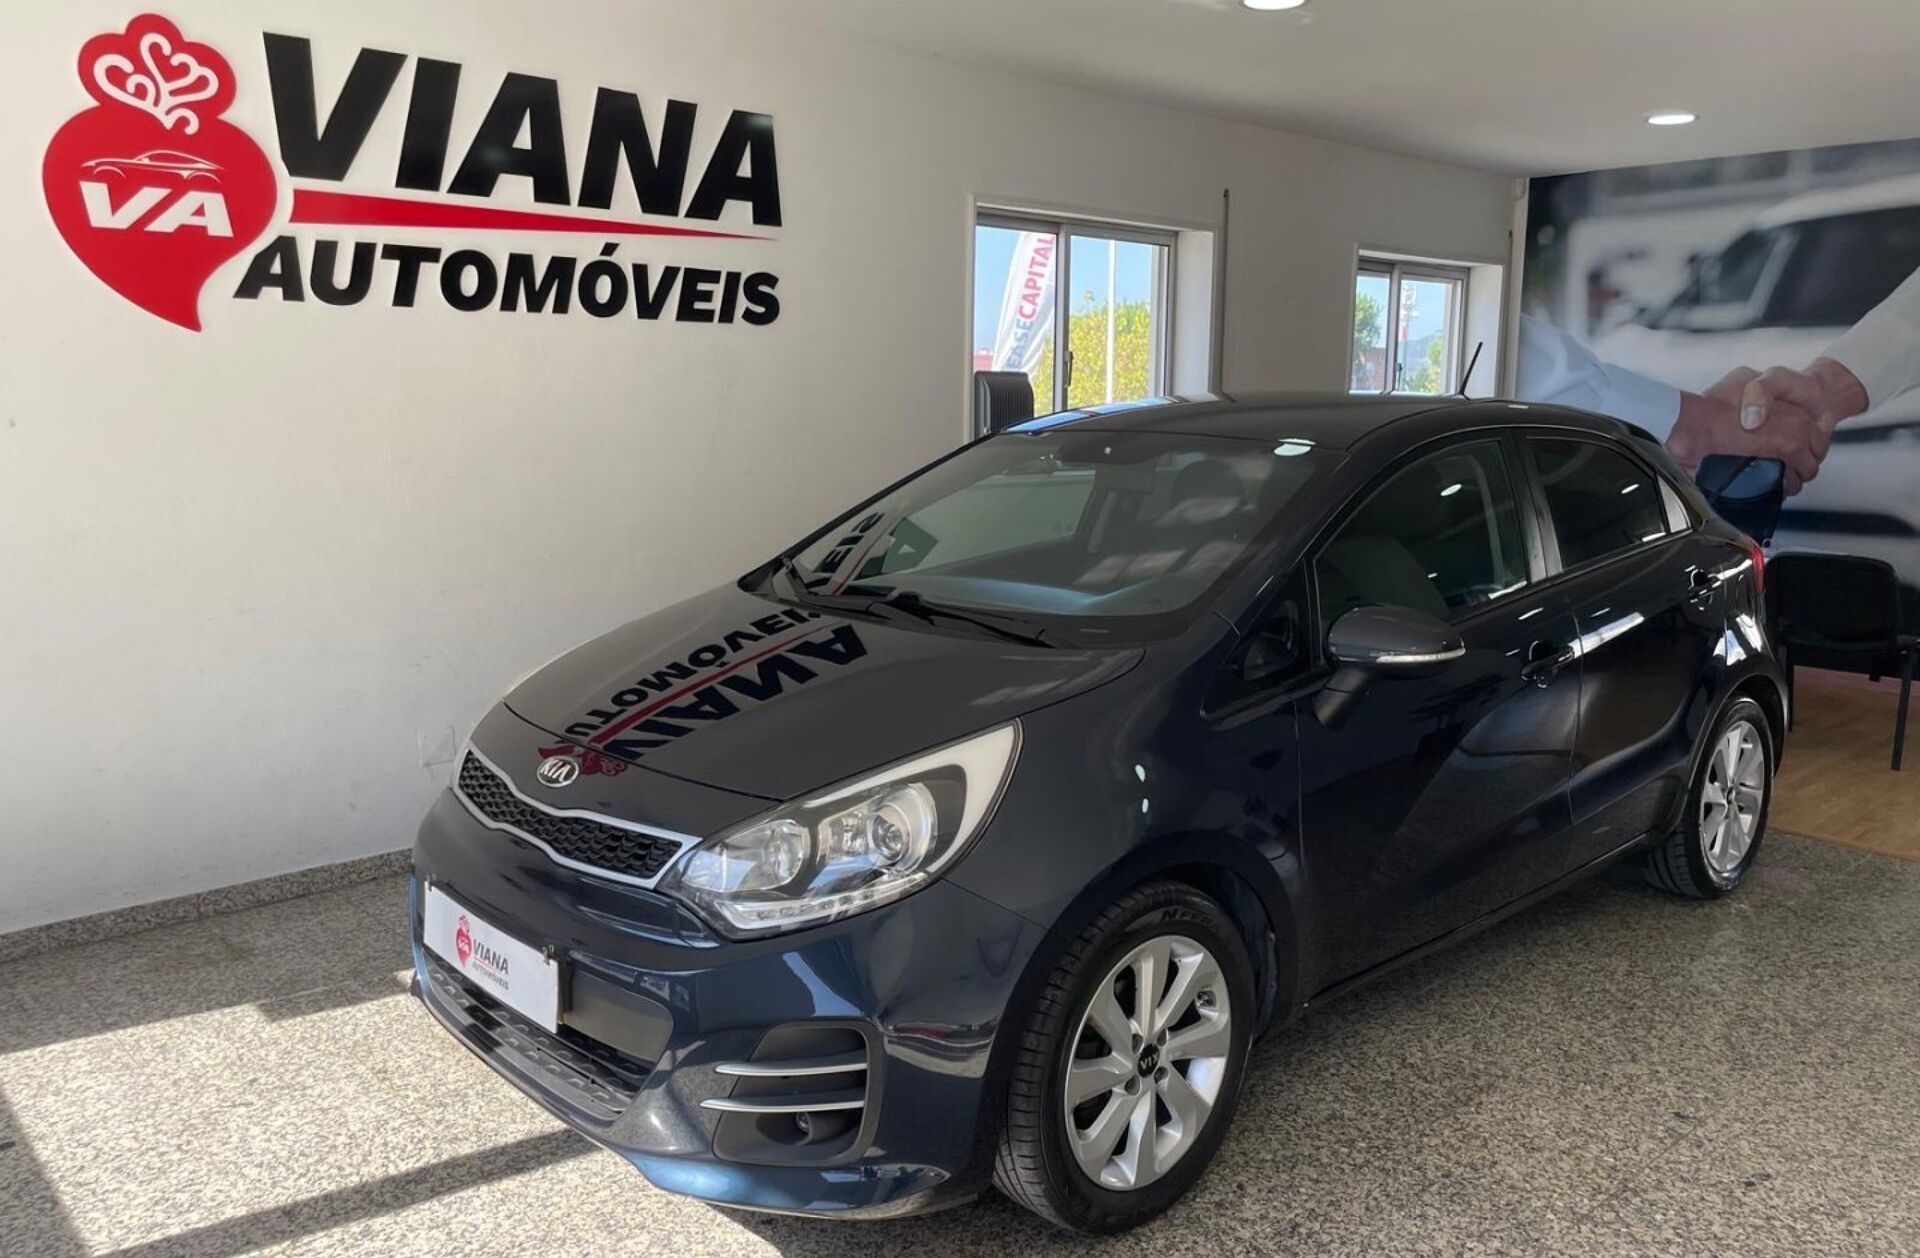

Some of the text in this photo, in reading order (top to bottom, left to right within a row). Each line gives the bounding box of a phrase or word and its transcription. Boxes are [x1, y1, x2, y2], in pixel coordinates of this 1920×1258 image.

[263, 31, 783, 228] VIANA
[78, 180, 235, 238] VA
[232, 234, 781, 326] AUTOMÓVEIS
[1003, 236, 1055, 371] EASECAPITAL
[539, 757, 572, 783] KIA
[473, 939, 509, 975] VIANA
